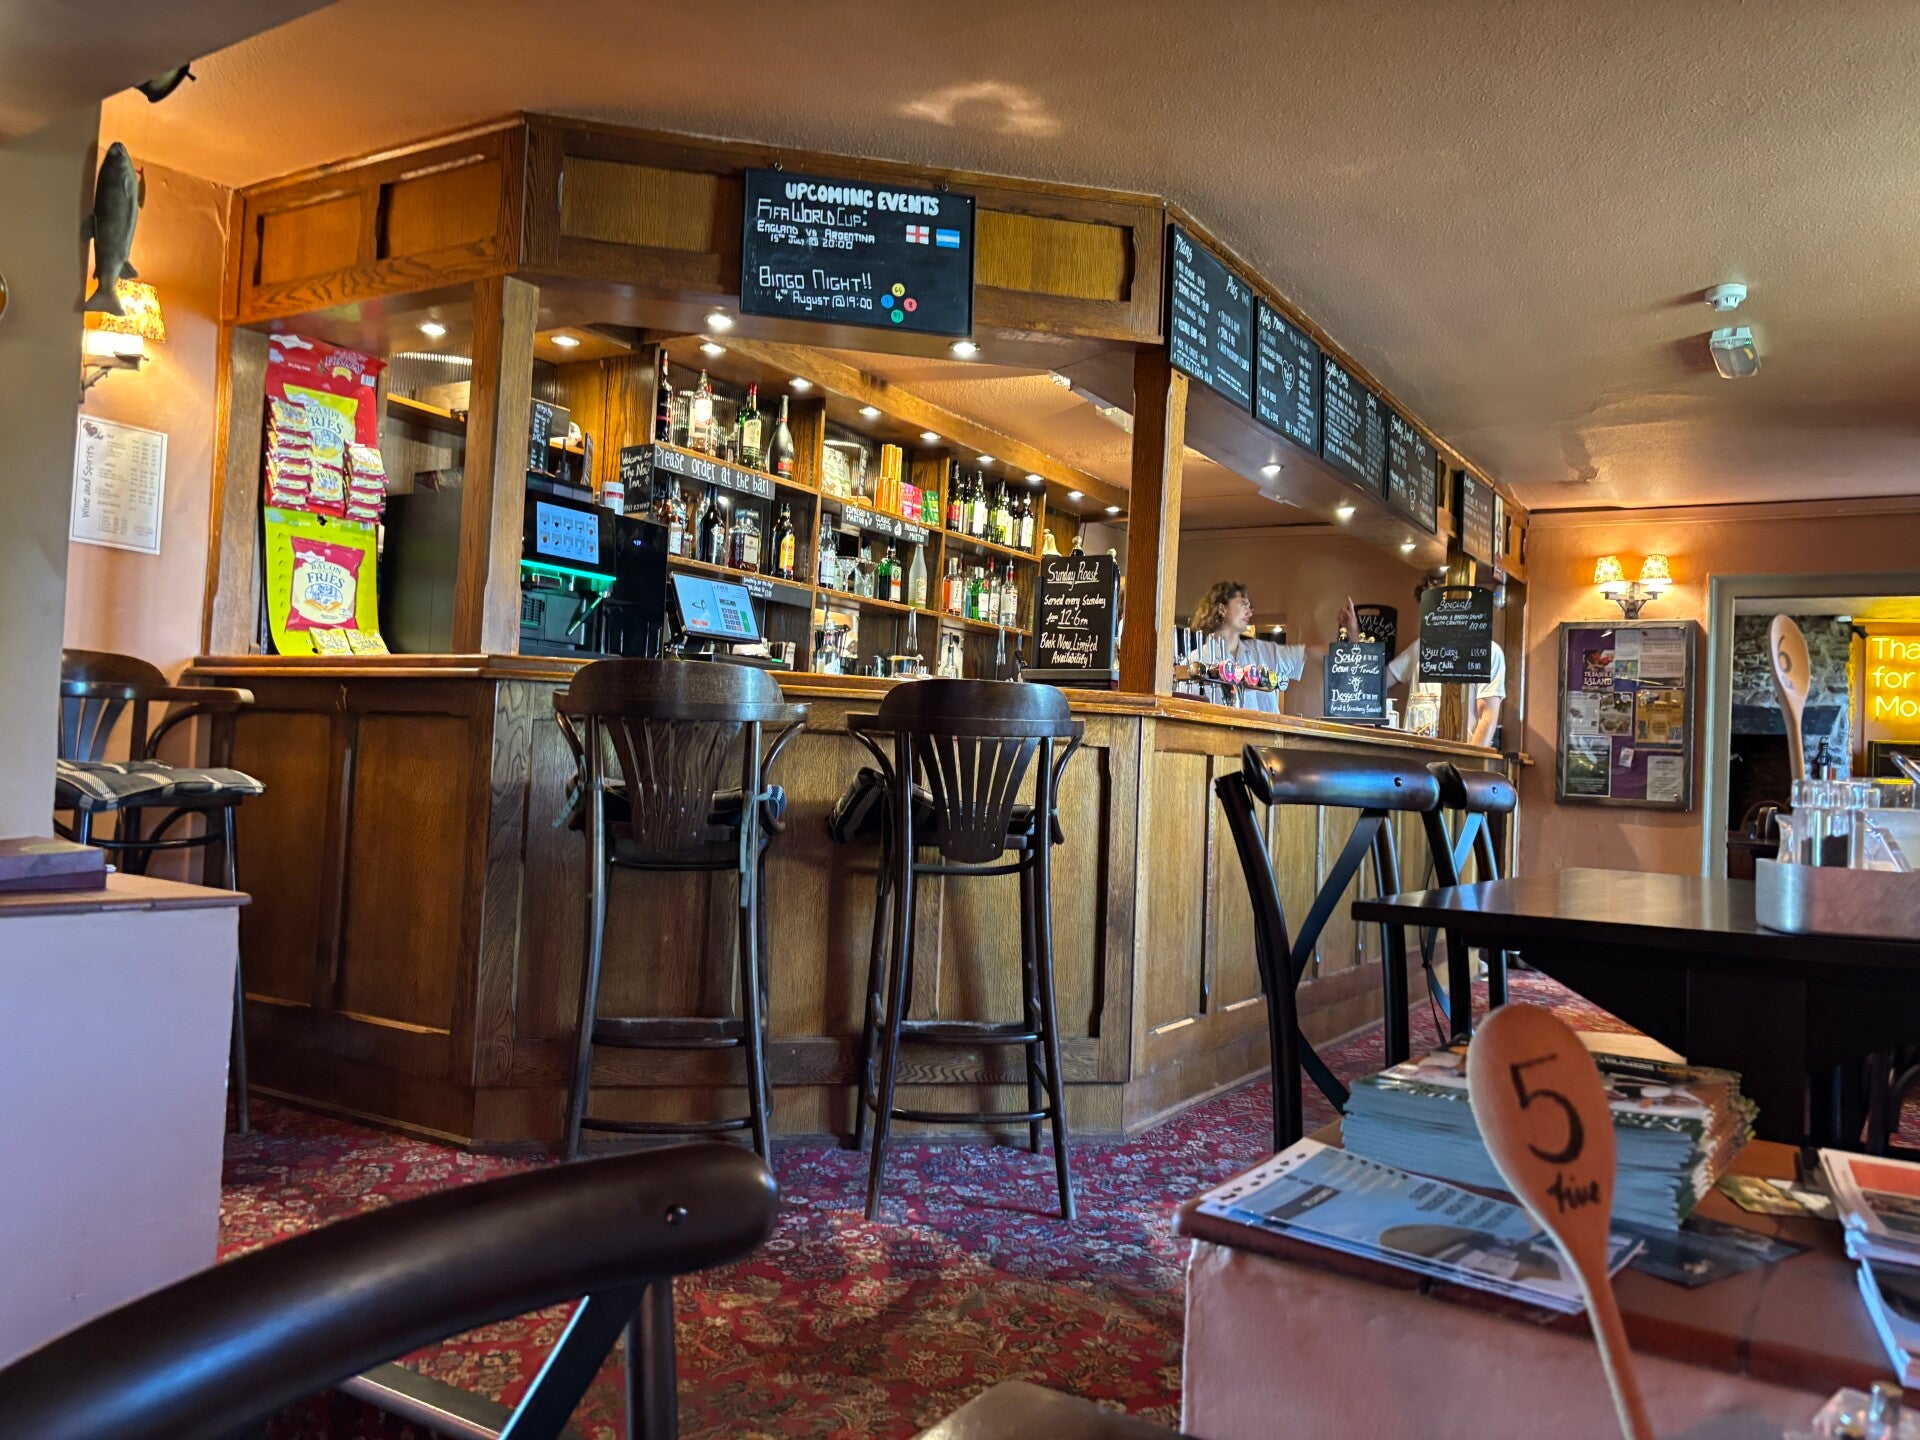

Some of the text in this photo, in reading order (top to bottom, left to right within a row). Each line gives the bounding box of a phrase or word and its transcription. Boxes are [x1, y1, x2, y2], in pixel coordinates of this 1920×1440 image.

[785, 182, 939, 216] UPCOMING EVENTS
[757, 198, 789, 221] FIFA
[792, 202, 835, 226] WORLD
[822, 238, 853, 250] 20:00
[760, 266, 805, 290] BINGO
[310, 416, 344, 434] RIES
[622, 468, 635, 479] The
[654, 446, 685, 472] Please
[691, 458, 716, 481] order
[721, 467, 732, 486] at
[736, 471, 749, 490] the
[311, 563, 342, 576] BACON
[1047, 561, 1100, 591] Sunday Roast
[307, 572, 346, 590] FRIES
[1044, 594, 1106, 610] Served every Sunday
[1437, 600, 1473, 613] Specials
[1040, 632, 1056, 648] Book
[1072, 633, 1098, 652] Limited
[1334, 648, 1362, 664] Soup
[1778, 635, 1792, 673] 6
[1584, 677, 1613, 686] ISLAND
[1871, 665, 1916, 689] for
[1331, 689, 1362, 702] Dessert
[1875, 695, 1920, 718] Mo
[1509, 1053, 1585, 1165] 5
